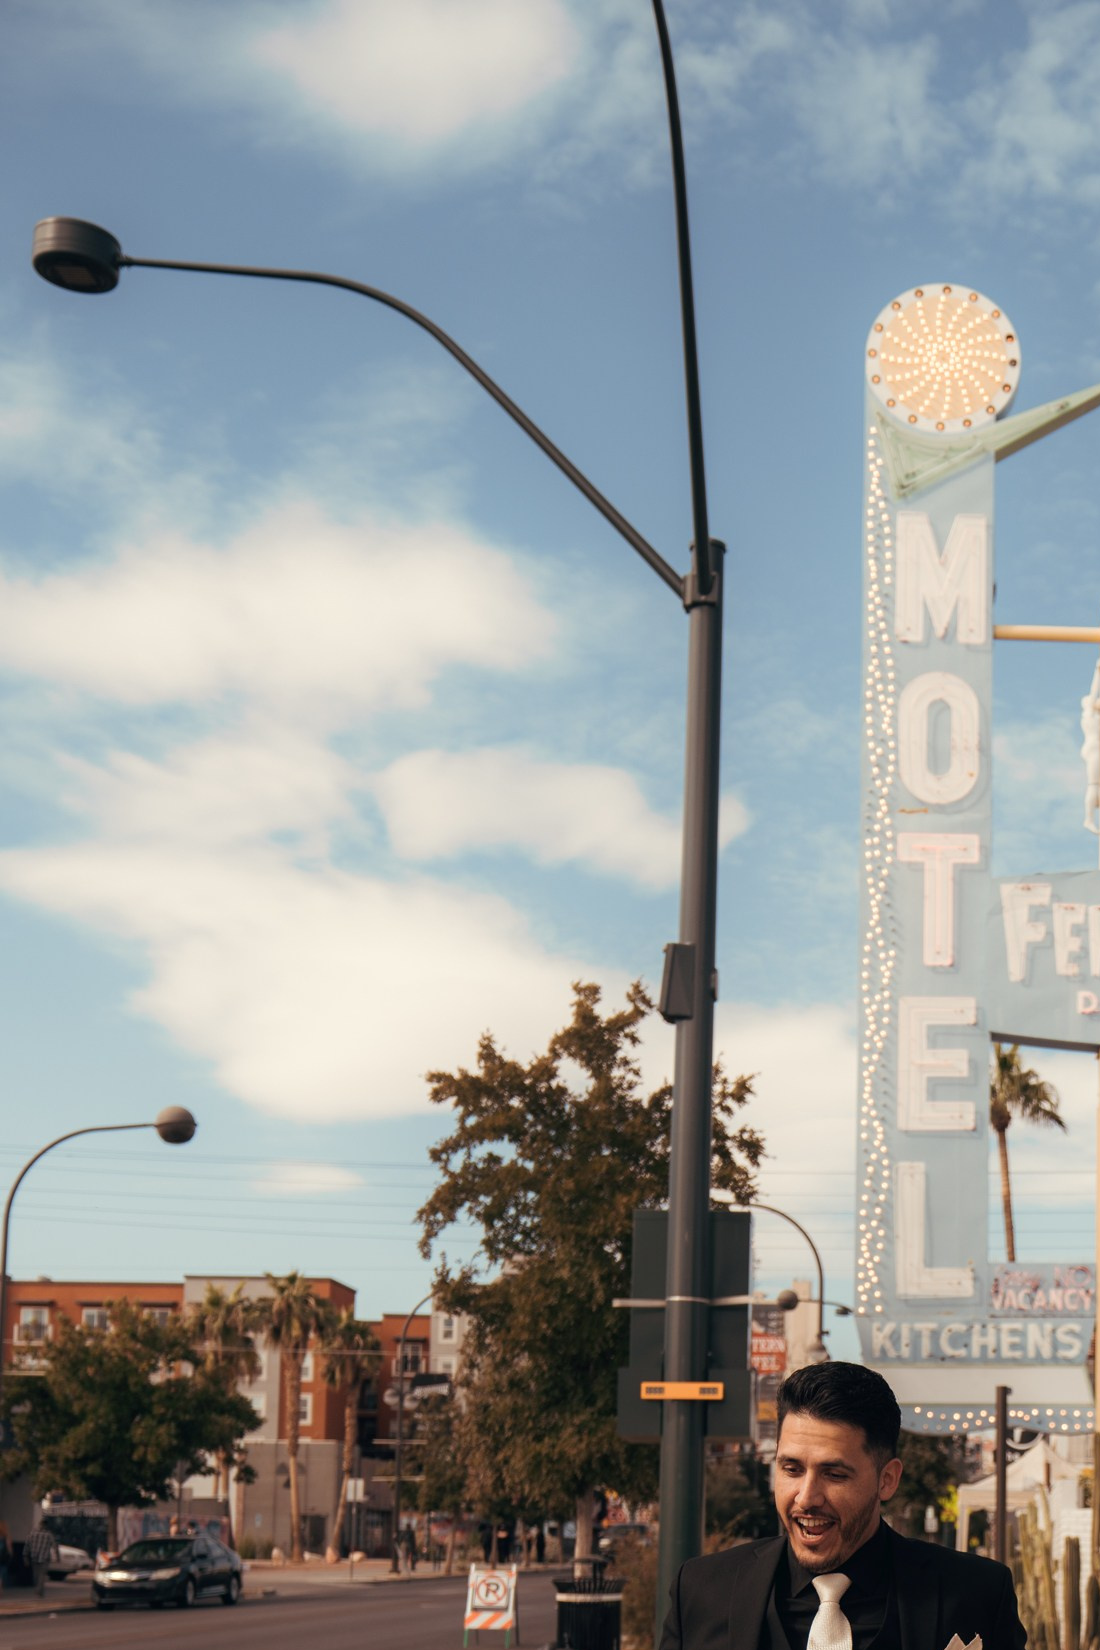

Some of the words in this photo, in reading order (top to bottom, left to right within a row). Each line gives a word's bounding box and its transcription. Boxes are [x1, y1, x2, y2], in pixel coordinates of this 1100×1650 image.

[894, 511, 987, 1299] MOTEL
[991, 1288, 1093, 1312] VACANCY
[752, 1336, 786, 1353] TERN
[871, 1322, 1085, 1359] KITCHENS
[752, 1356, 781, 1372] TEL
